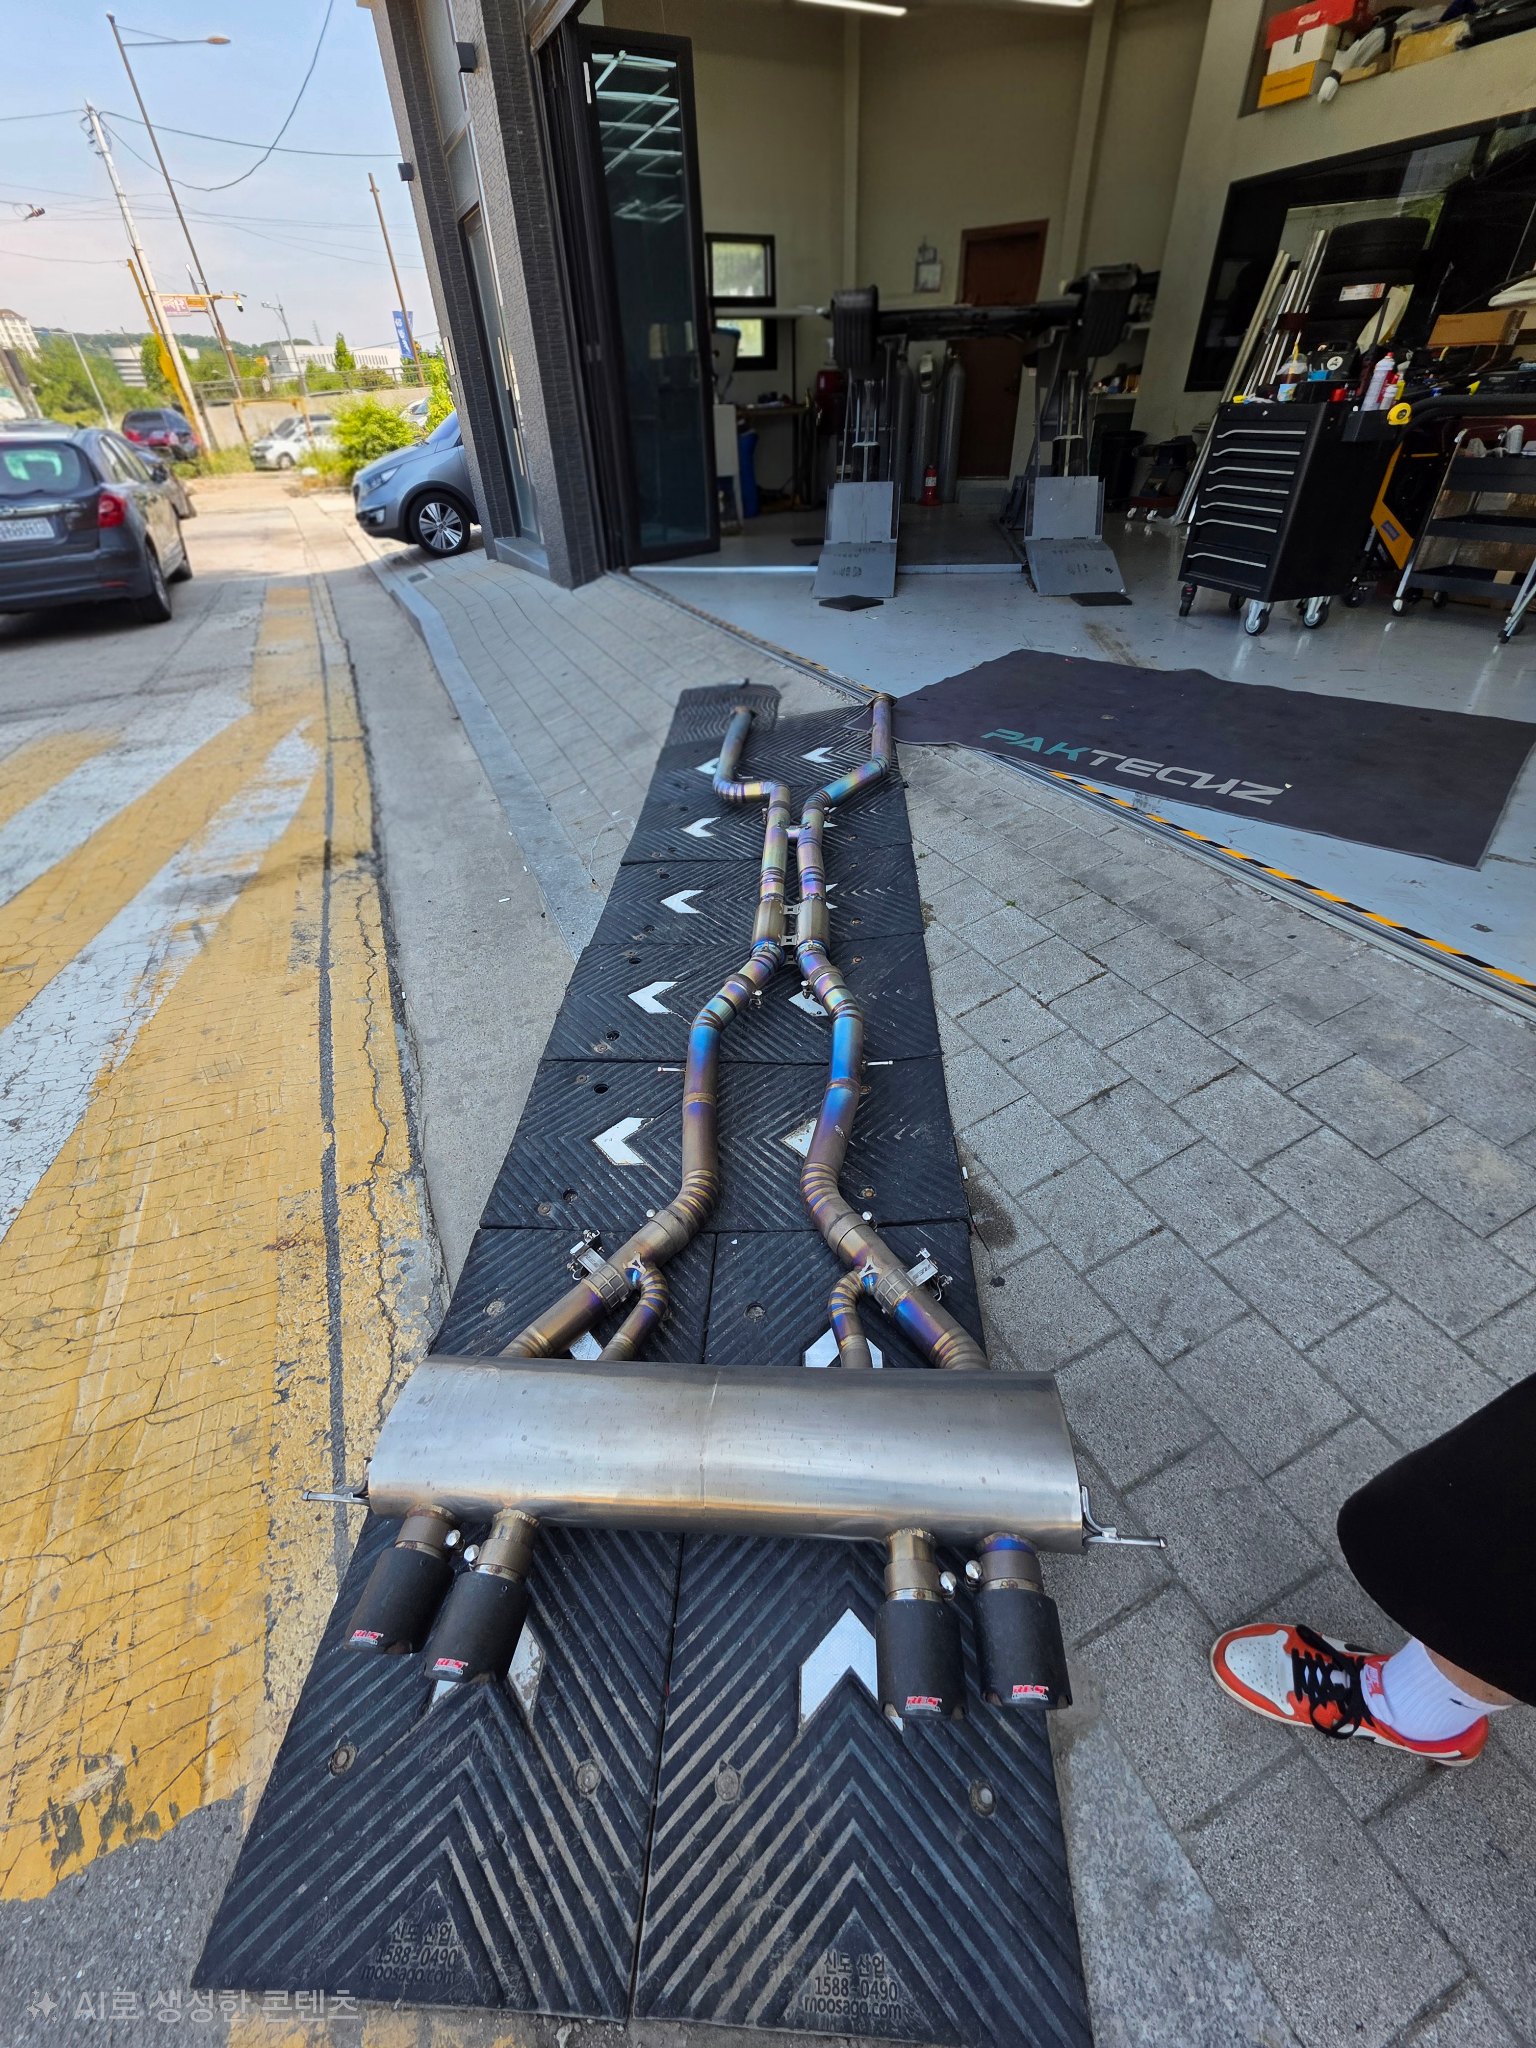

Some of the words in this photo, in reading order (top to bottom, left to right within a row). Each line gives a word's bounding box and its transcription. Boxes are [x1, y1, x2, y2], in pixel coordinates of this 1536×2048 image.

[392, 1922, 420, 1943] 신도
[423, 1922, 453, 1947] 산업
[824, 1951, 852, 1975] 신도
[857, 1953, 885, 1980] 산업
[804, 1996, 902, 2020] moosago.com
